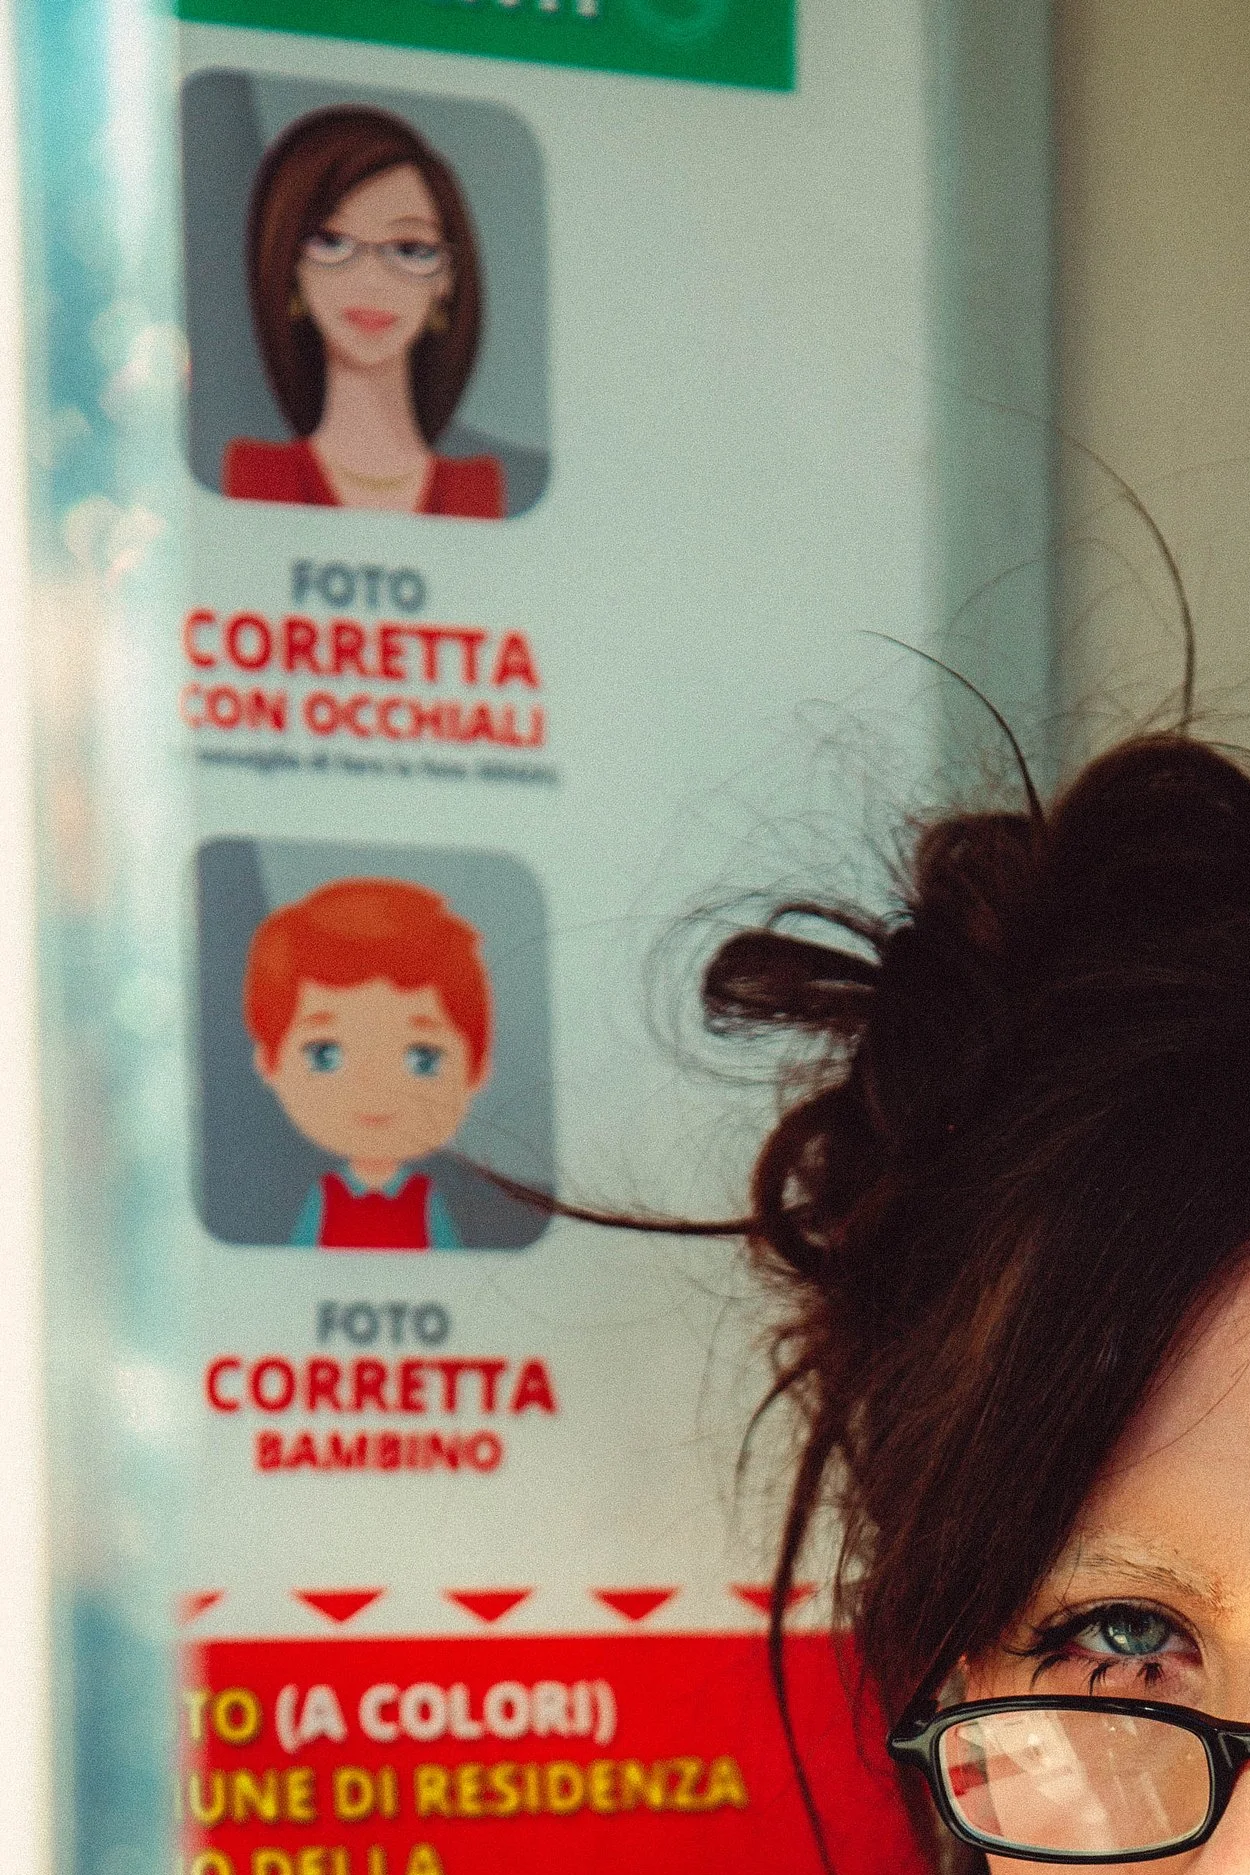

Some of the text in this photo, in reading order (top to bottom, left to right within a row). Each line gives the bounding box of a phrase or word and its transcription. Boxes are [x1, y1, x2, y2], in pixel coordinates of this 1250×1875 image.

[291, 561, 427, 613] FOTO
[183, 606, 543, 689] CORRETTA
[181, 683, 545, 748] CON OCCHIALI
[316, 1301, 450, 1346] FOTO
[205, 1355, 558, 1415] CORRETTA
[256, 1431, 502, 1472] BAMBINO
[275, 1685, 347, 1752] (A
[358, 1680, 618, 1746] COLORI)
[334, 1765, 397, 1820] DI
[413, 1756, 749, 1818] RESIDENZA
